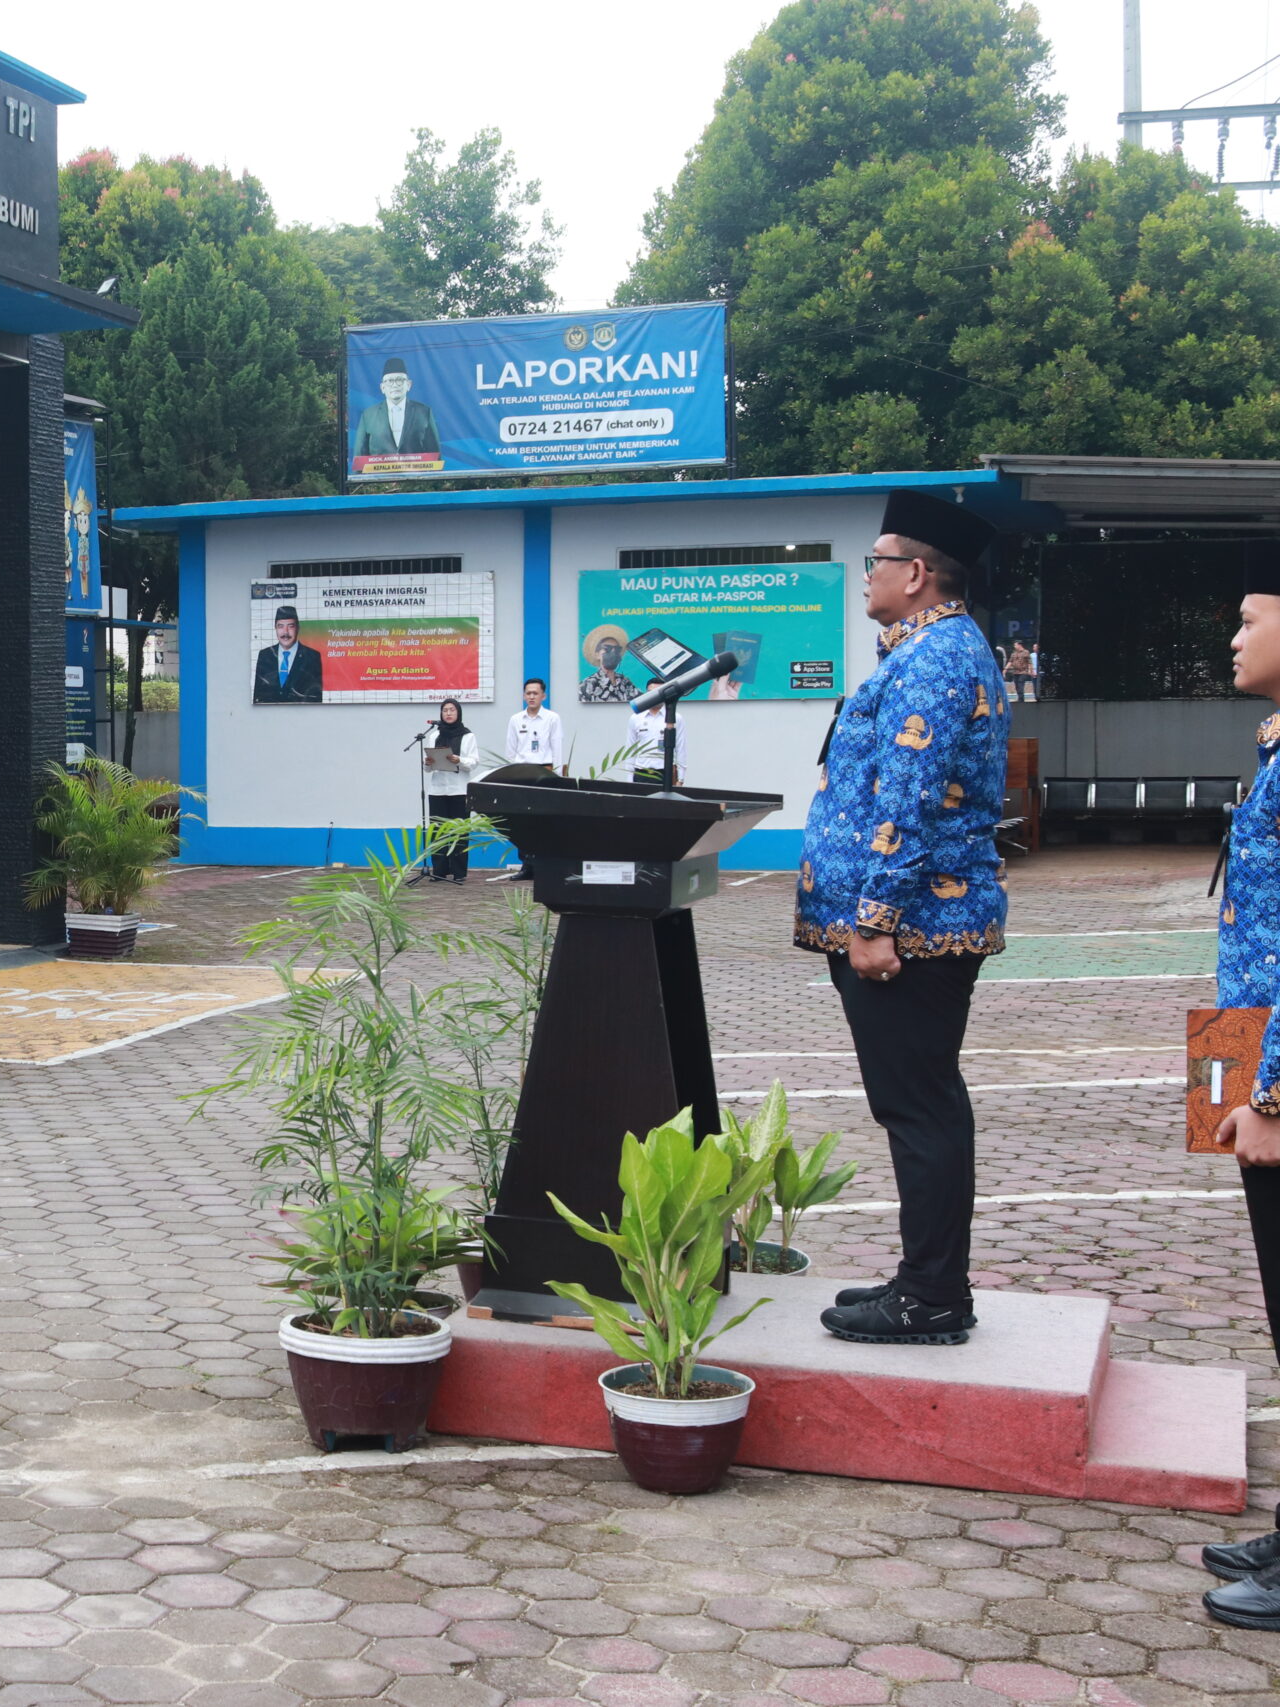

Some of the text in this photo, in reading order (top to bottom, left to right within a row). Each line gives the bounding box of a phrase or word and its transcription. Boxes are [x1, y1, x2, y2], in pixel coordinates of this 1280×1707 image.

[5, 96, 36, 142] TPI
[476, 350, 698, 390] LAPORKAN!
[479, 386, 695, 406] JIKA TERJADI KENDALA DALAM PELAYANAN KAMI
[542, 402, 583, 411] HUBUNGI
[595, 399, 630, 408] NOMOR
[508, 420, 547, 436] 0724
[553, 418, 603, 434] 21467
[606, 418, 633, 431] (chat
[636, 418, 658, 429] only
[495, 447, 517, 455] KAMI
[519, 443, 584, 454] BERKOMITMEN
[586, 442, 617, 451] UNTUK
[618, 439, 679, 450] MEMBERIKAN
[523, 452, 575, 463] PELAYANAN
[577, 450, 614, 460] SANGAT
[615, 449, 637, 458] BAIK
[620, 573, 799, 591] MAU PUNYA PASPOR ?
[322, 587, 428, 597] KEMENTERIAN IMIGRASI
[653, 591, 765, 603] DAFTAR M-PASPOR
[324, 598, 426, 608] DAN PEMASYARAKATAN
[646, 606, 708, 615] PENDAFTARAN
[710, 605, 749, 614] ANTRIAN
[751, 605, 787, 613] PASPOR
[789, 604, 822, 612] ONLINE
[363, 628, 389, 638] apabila
[327, 639, 355, 648] kepada
[356, 640, 379, 648] orang
[379, 648, 408, 658] kepada
[366, 666, 430, 675] Agus Ardianto
